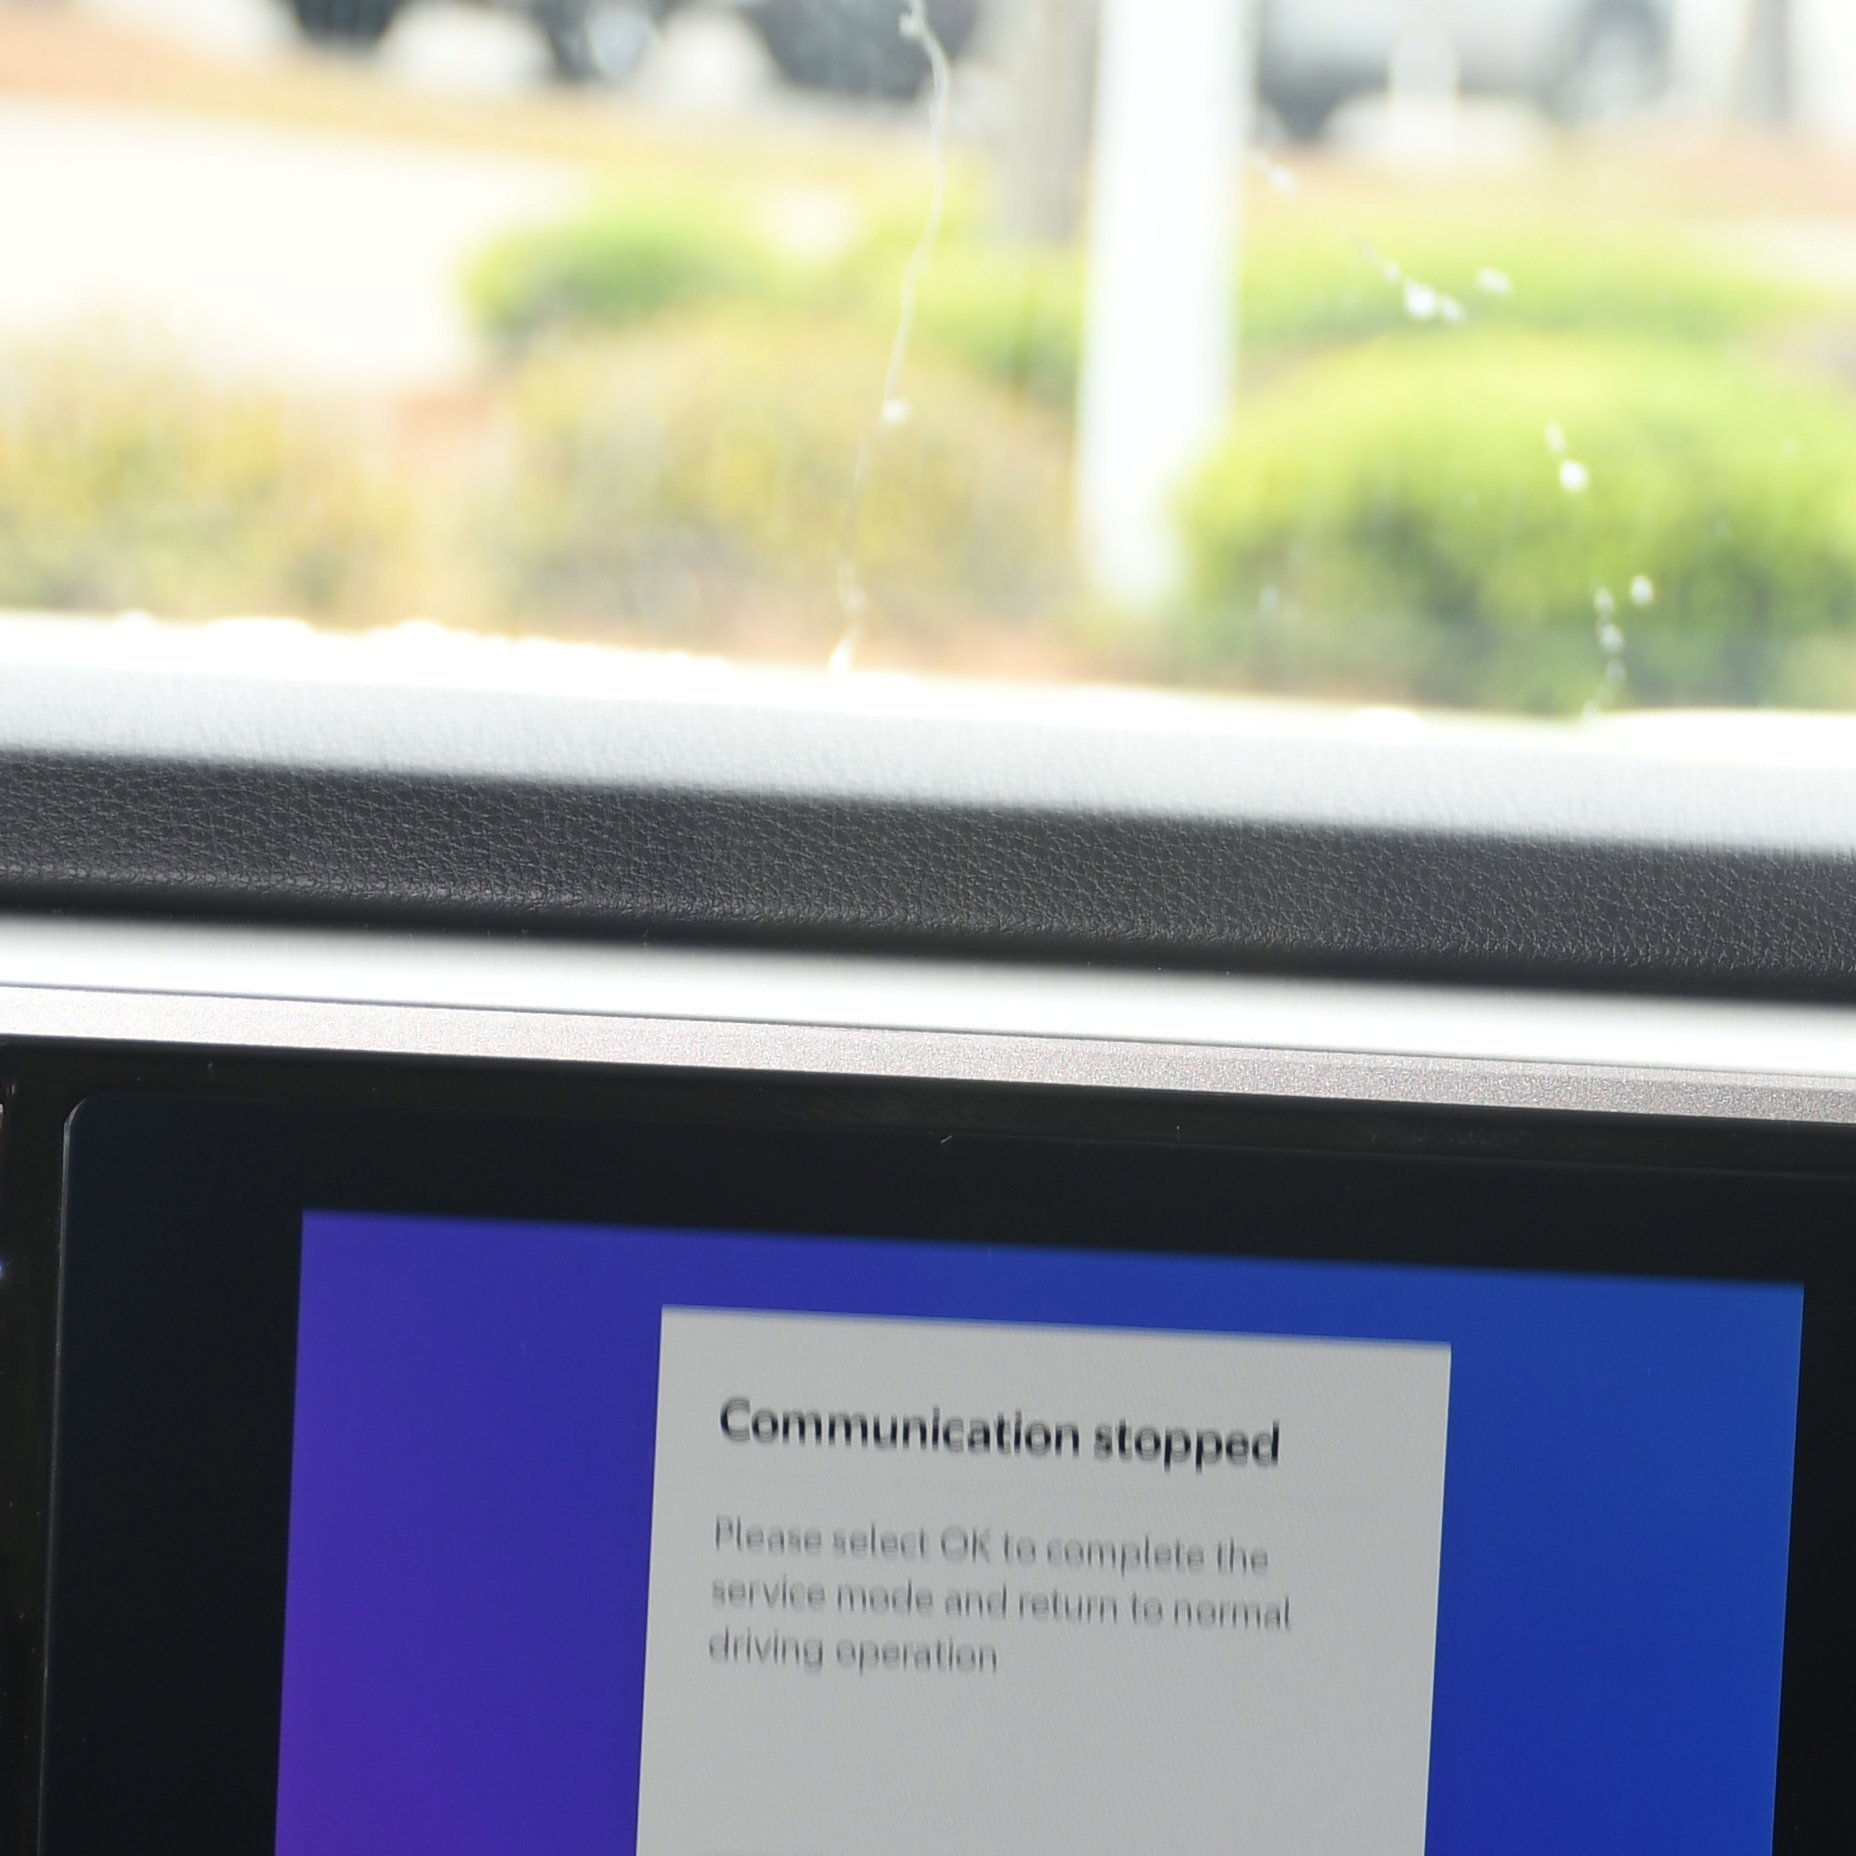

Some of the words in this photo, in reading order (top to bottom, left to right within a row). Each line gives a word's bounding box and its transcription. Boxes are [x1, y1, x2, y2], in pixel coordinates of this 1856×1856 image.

[720, 1396, 1079, 1458] Communication
[1094, 1418, 1279, 1475] stopped
[715, 1514, 822, 1556] Please
[832, 1522, 928, 1562] select
[940, 1525, 991, 1564] OK
[1002, 1530, 1036, 1568] to
[1046, 1535, 1204, 1578] complete
[1216, 1539, 1268, 1576] the
[712, 1573, 826, 1611] service
[836, 1578, 933, 1617] mode
[945, 1584, 1006, 1619] and
[1018, 1589, 1117, 1624] return
[1128, 1593, 1162, 1625] to
[1173, 1596, 1290, 1630] normal
[709, 1625, 823, 1672] driving
[835, 1637, 998, 1676] operation
